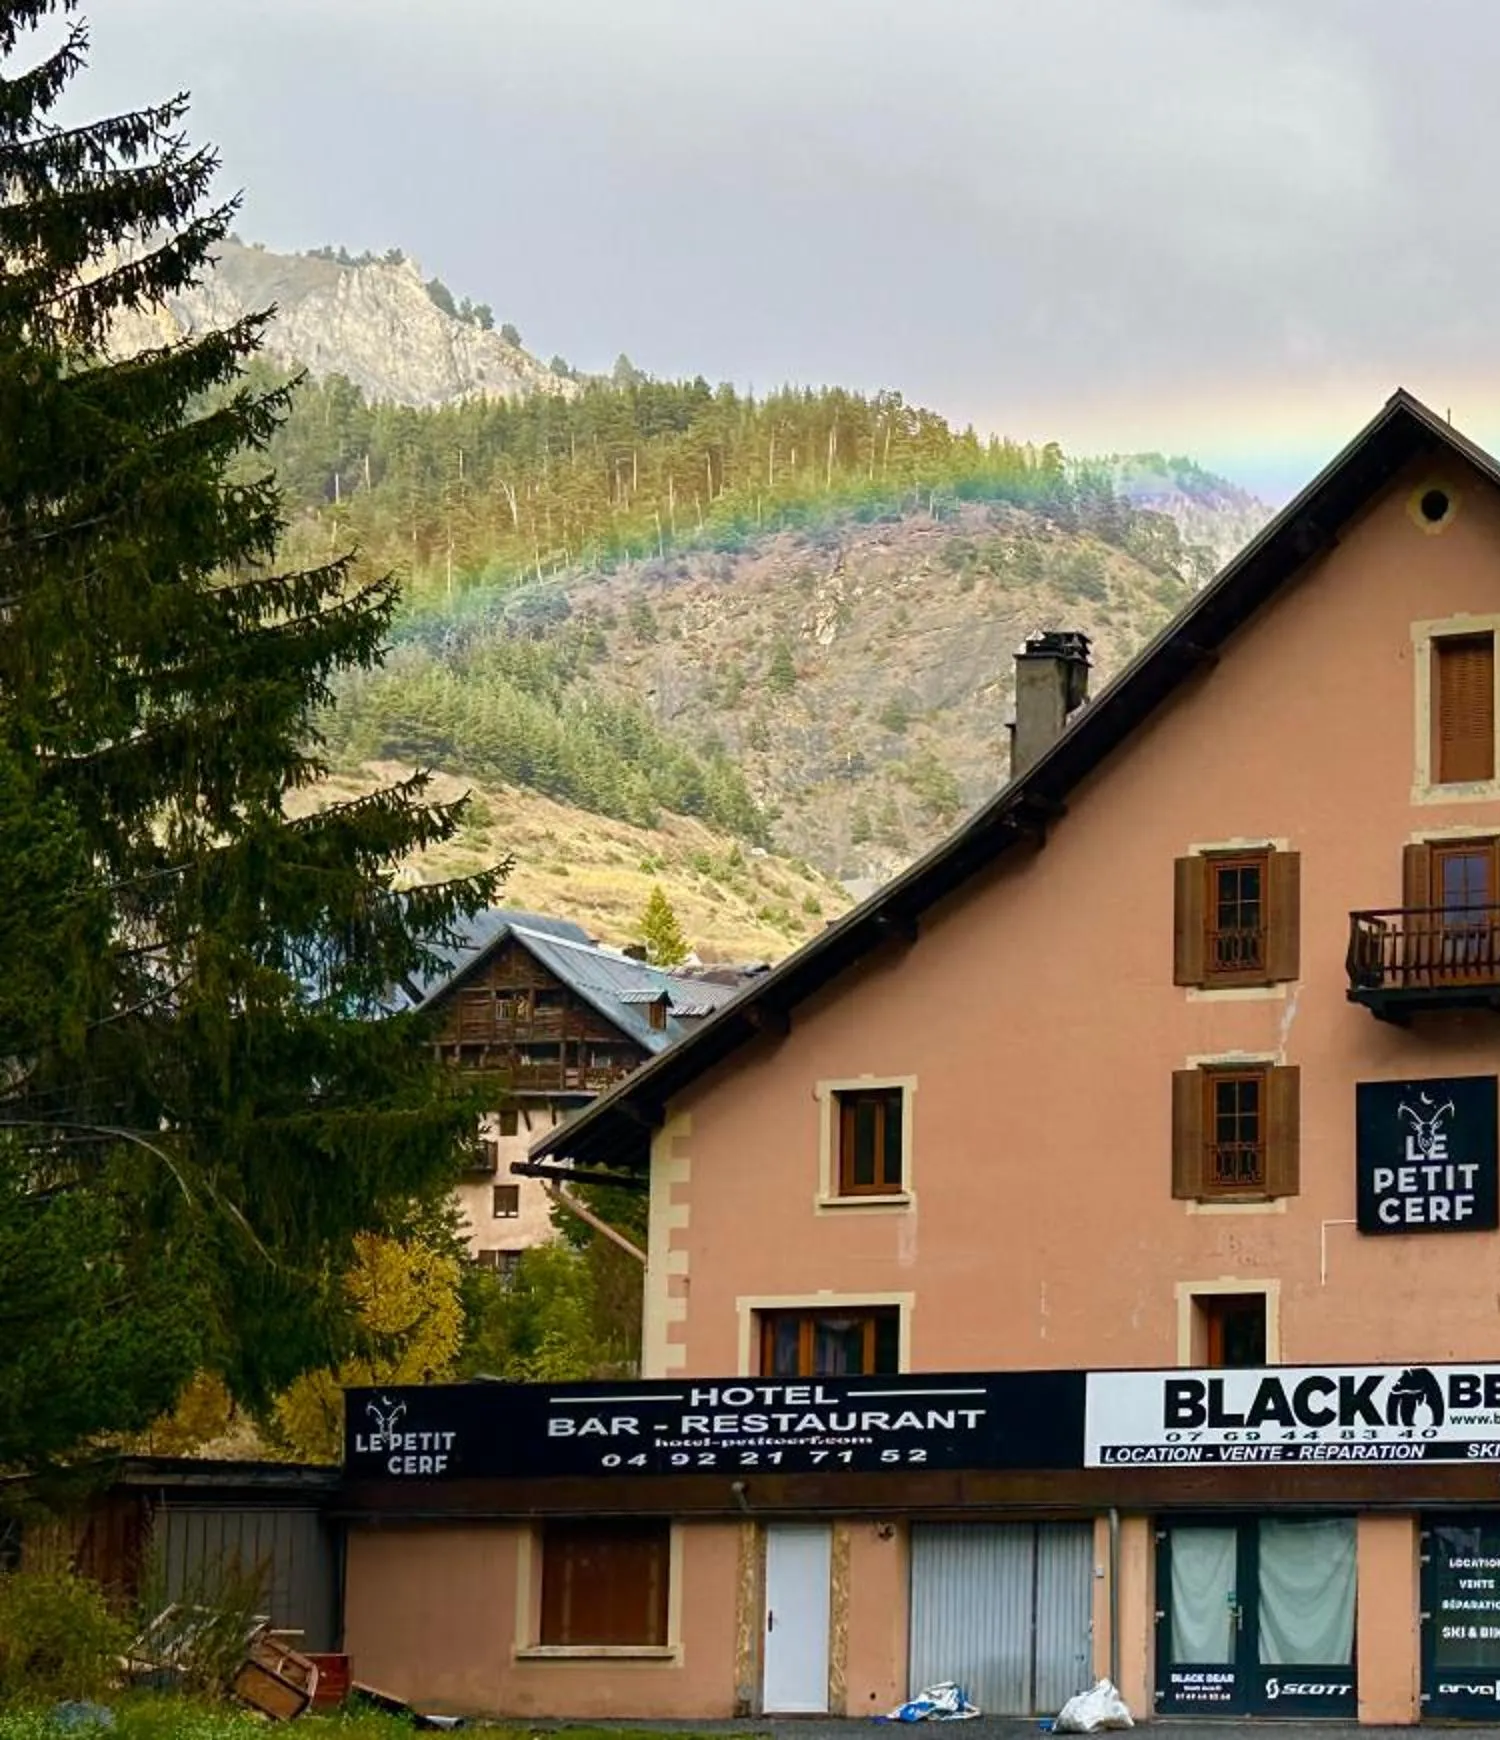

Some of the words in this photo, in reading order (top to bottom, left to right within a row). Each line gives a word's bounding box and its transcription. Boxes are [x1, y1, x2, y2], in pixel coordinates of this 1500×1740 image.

[1405, 1133, 1449, 1161] LE
[1373, 1163, 1480, 1194] PETIT
[1377, 1194, 1475, 1224] CERF
[690, 1386, 839, 1407] HOTEL
[1164, 1375, 1385, 1428] BLACK
[547, 1416, 641, 1437] BAR
[681, 1409, 987, 1435] RESTAURANT
[355, 1433, 383, 1452] LE
[389, 1431, 456, 1451] PETIT
[1165, 1431, 1204, 1442] 07
[1223, 1431, 1261, 1442] 69
[1281, 1430, 1320, 1441] 44
[1398, 1429, 1438, 1439] 40
[601, 1453, 648, 1467] 04
[670, 1452, 717, 1466] 92
[739, 1451, 783, 1465] 21
[809, 1450, 853, 1464] 71
[880, 1449, 927, 1463] 52
[1104, 1447, 1203, 1462] LOCATION
[1219, 1445, 1283, 1461] VENTE
[1299, 1440, 1427, 1460] RÉPARATION
[1467, 1442, 1500, 1458] SKI
[387, 1455, 449, 1475] CERF
[1459, 1579, 1495, 1589] VENTE
[1442, 1625, 1465, 1639] SKI
[1171, 1673, 1205, 1683] BLACK
[1281, 1683, 1352, 1695] SCOTT
